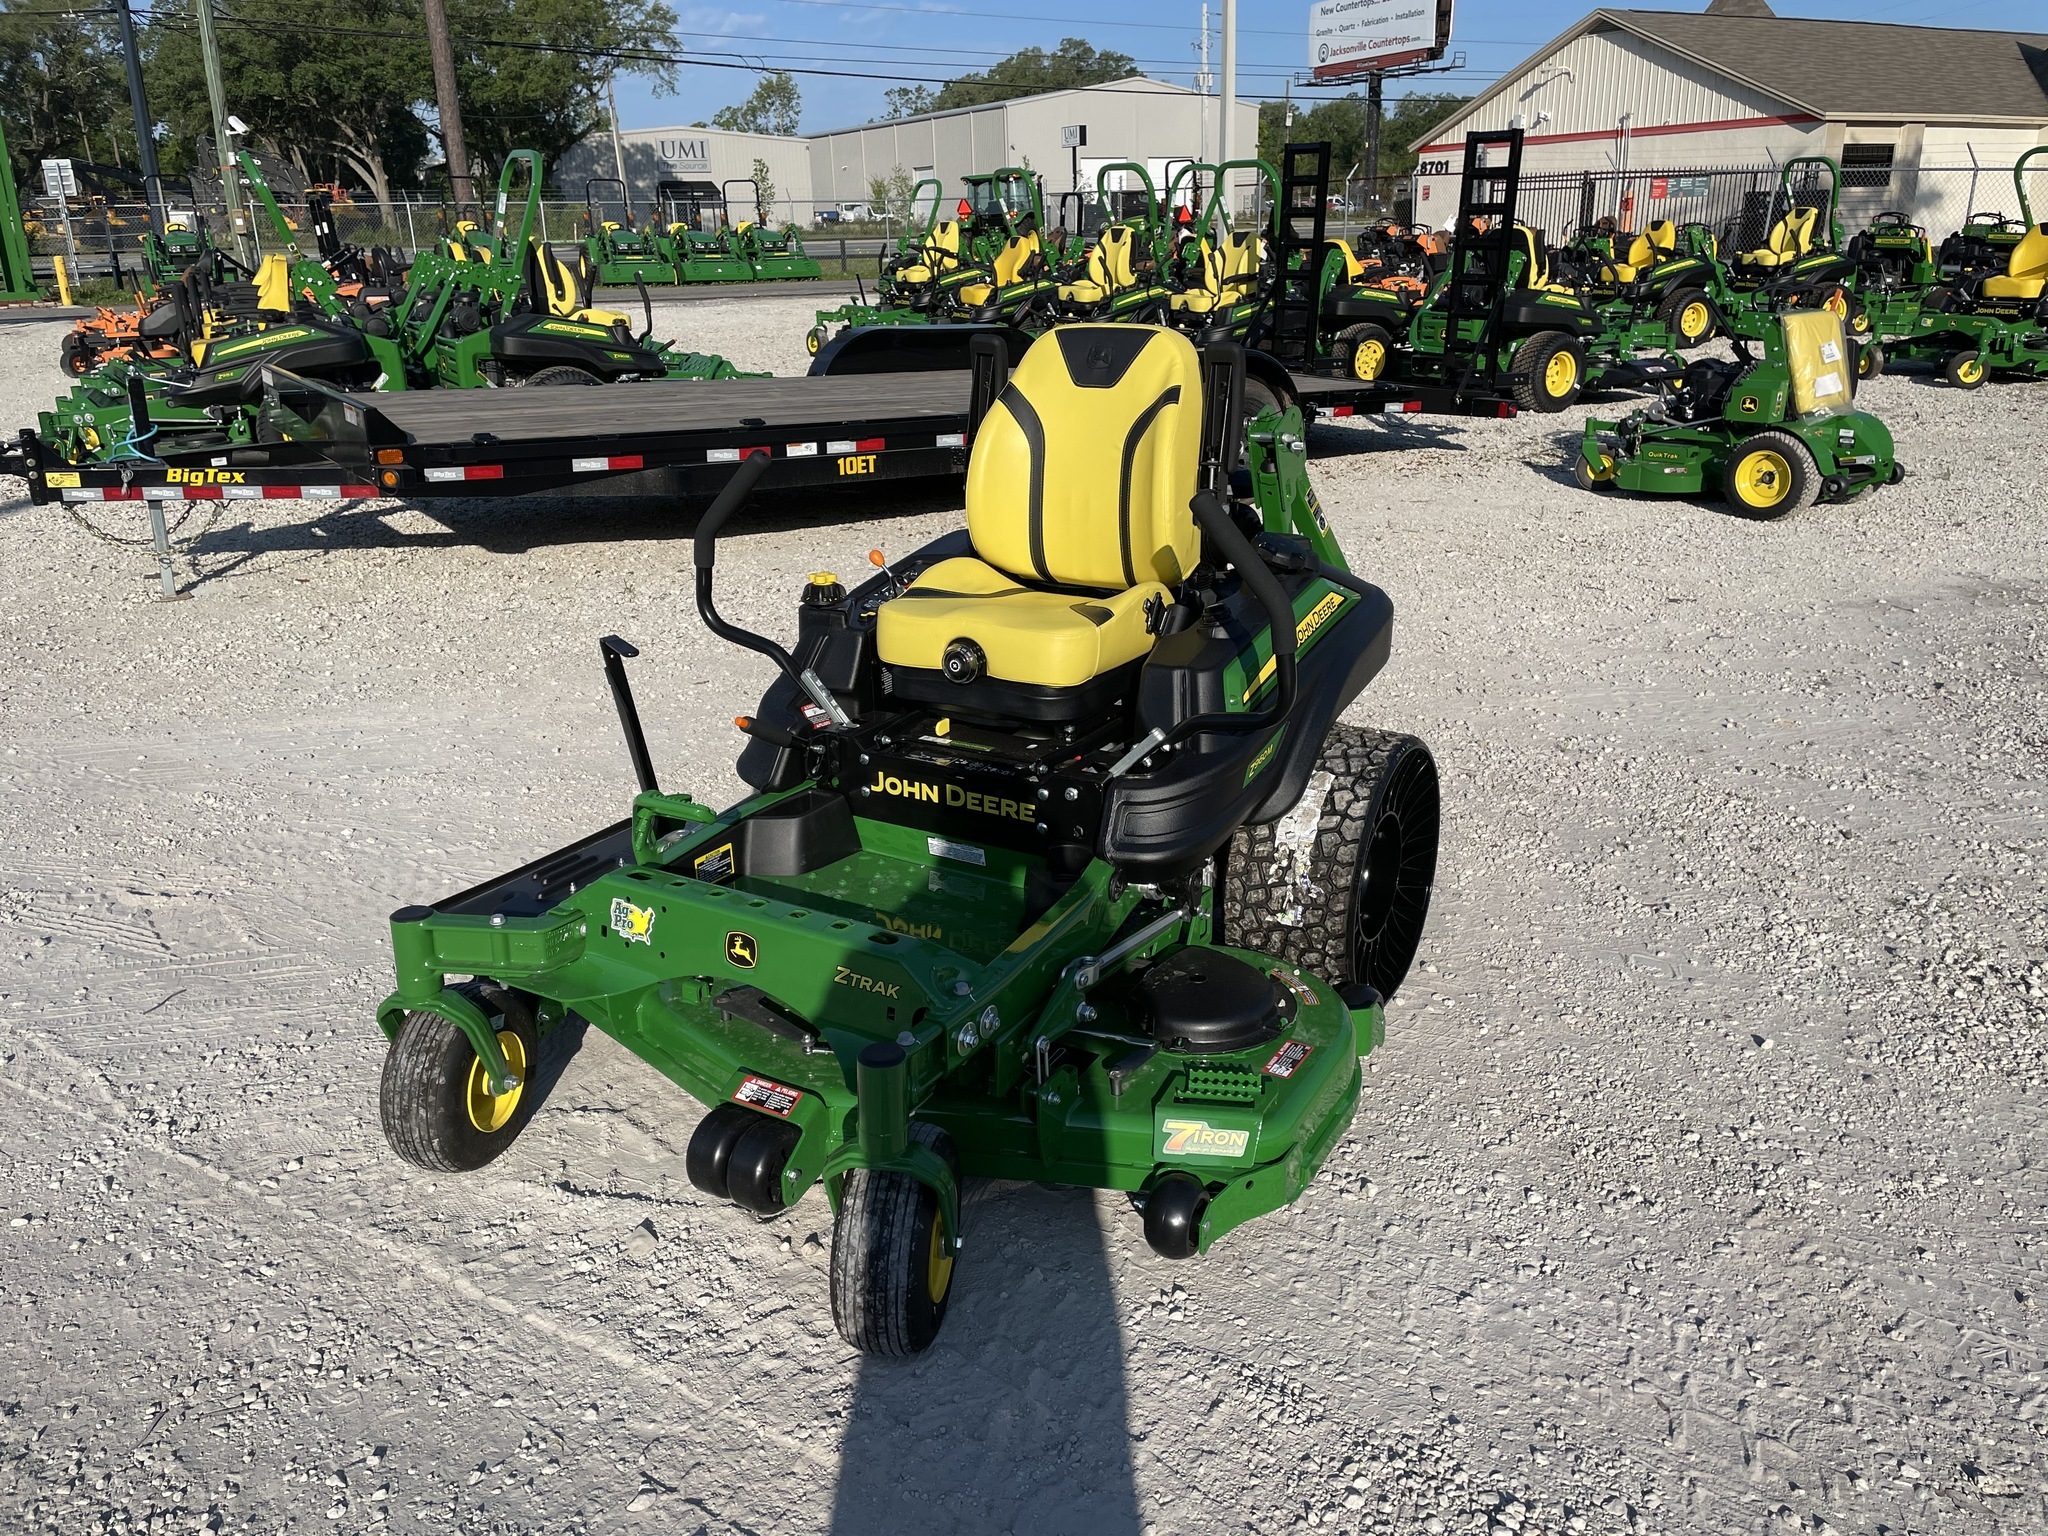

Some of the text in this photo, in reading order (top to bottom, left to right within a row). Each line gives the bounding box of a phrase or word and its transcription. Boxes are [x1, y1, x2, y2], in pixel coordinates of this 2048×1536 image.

[1321, 7, 1334, 16] New
[1316, 9, 1425, 36] Granite Quartz Fabrication Installation
[1329, 41, 1367, 57] Jacksonville
[660, 140, 707, 159] UMI
[680, 162, 708, 170] Source
[1420, 160, 1449, 174] 8701
[837, 455, 877, 476] 10ET
[166, 468, 246, 487] BigTex
[151, 489, 175, 497] BigTex
[231, 488, 255, 496] BigTex
[309, 488, 333, 496] BigTex
[1296, 597, 1336, 643] OHN DEERE
[870, 771, 1036, 823] JOHN DEERE
[614, 901, 634, 919] Ag-
[614, 914, 634, 929] Pro
[833, 966, 901, 999] ZTRAK
